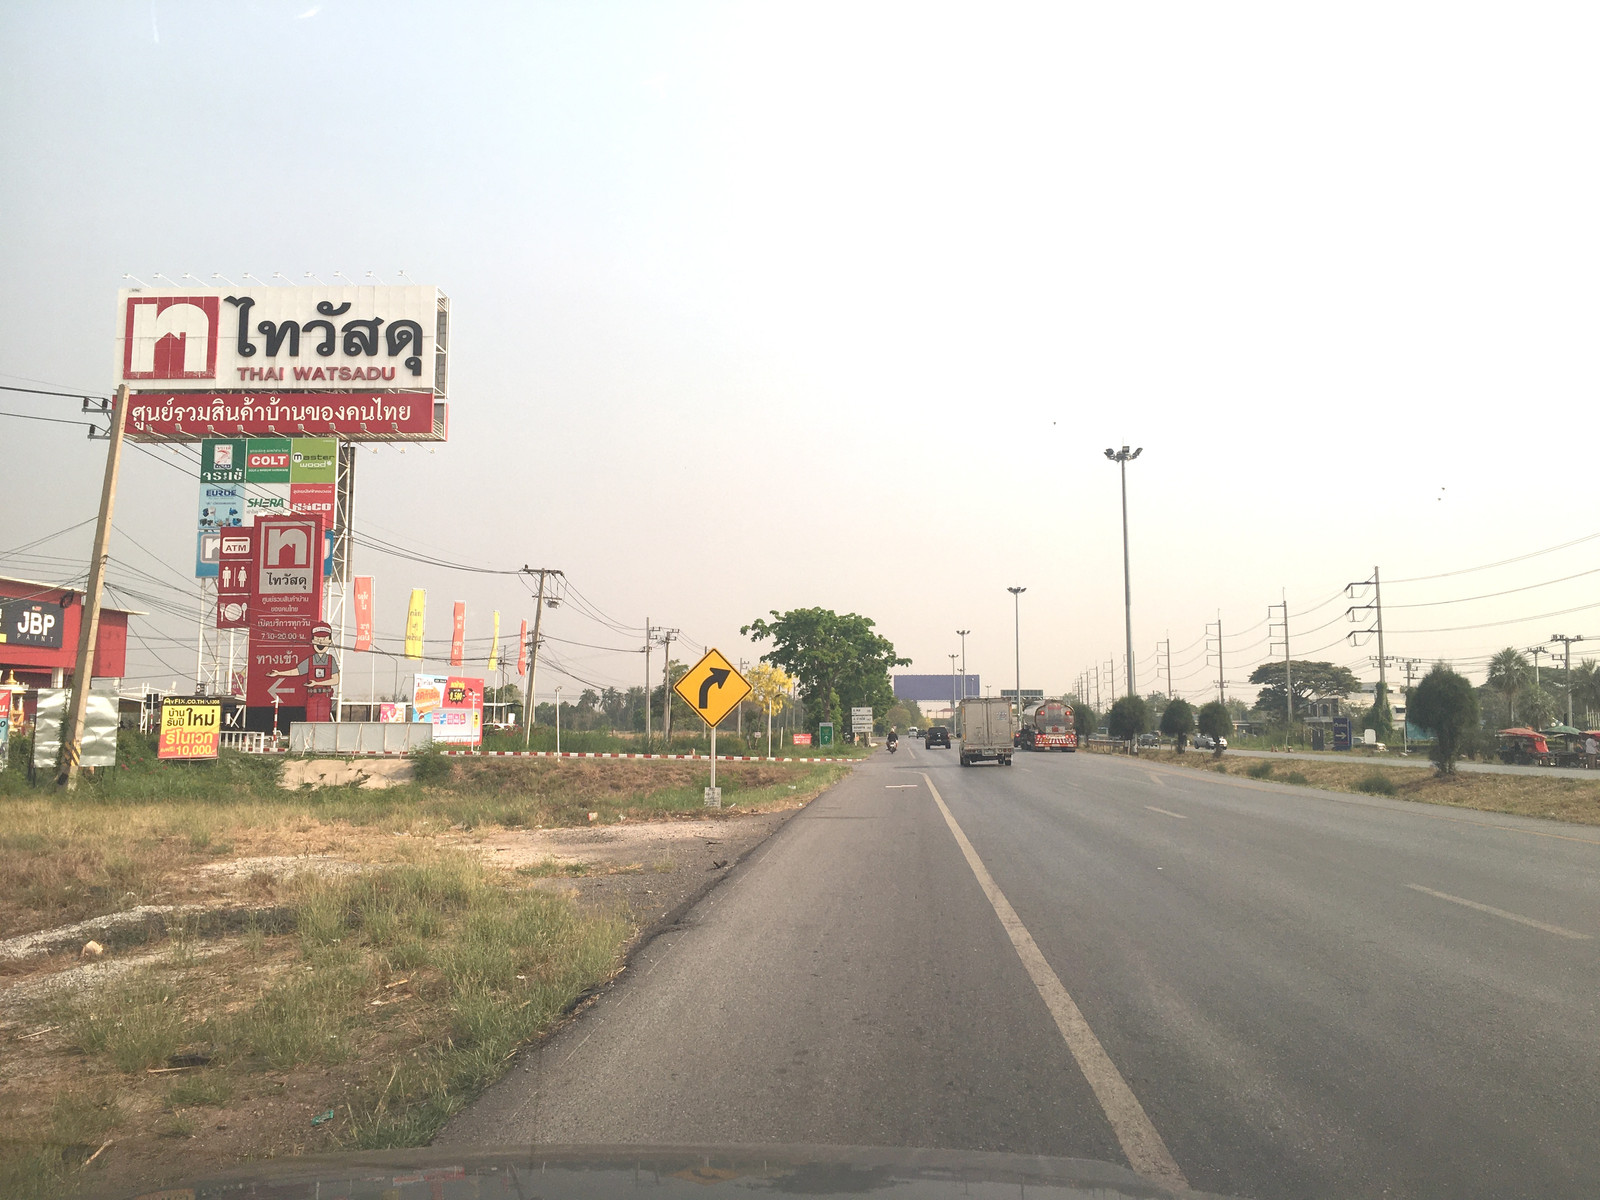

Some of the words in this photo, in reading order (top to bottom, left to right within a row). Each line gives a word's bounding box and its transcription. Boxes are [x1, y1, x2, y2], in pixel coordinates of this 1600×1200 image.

[223, 295, 423, 377] ไทวัสดุ
[237, 366, 284, 381] THAI
[292, 366, 396, 381] WATSADU
[132, 397, 411, 431] ศูนย์รวมสินค้าบ้านของคนไทย
[251, 456, 286, 466] COLT
[293, 454, 335, 462] master
[247, 498, 284, 508] SHERA
[225, 544, 247, 552] ATM
[266, 572, 307, 590] ไทวัสดุ
[17, 611, 56, 636] JBP
[16, 633, 54, 643] PAINT
[256, 650, 299, 665] ทางเข้า
[168, 708, 185, 717] บ้าน
[186, 707, 215, 726] ใหม่
